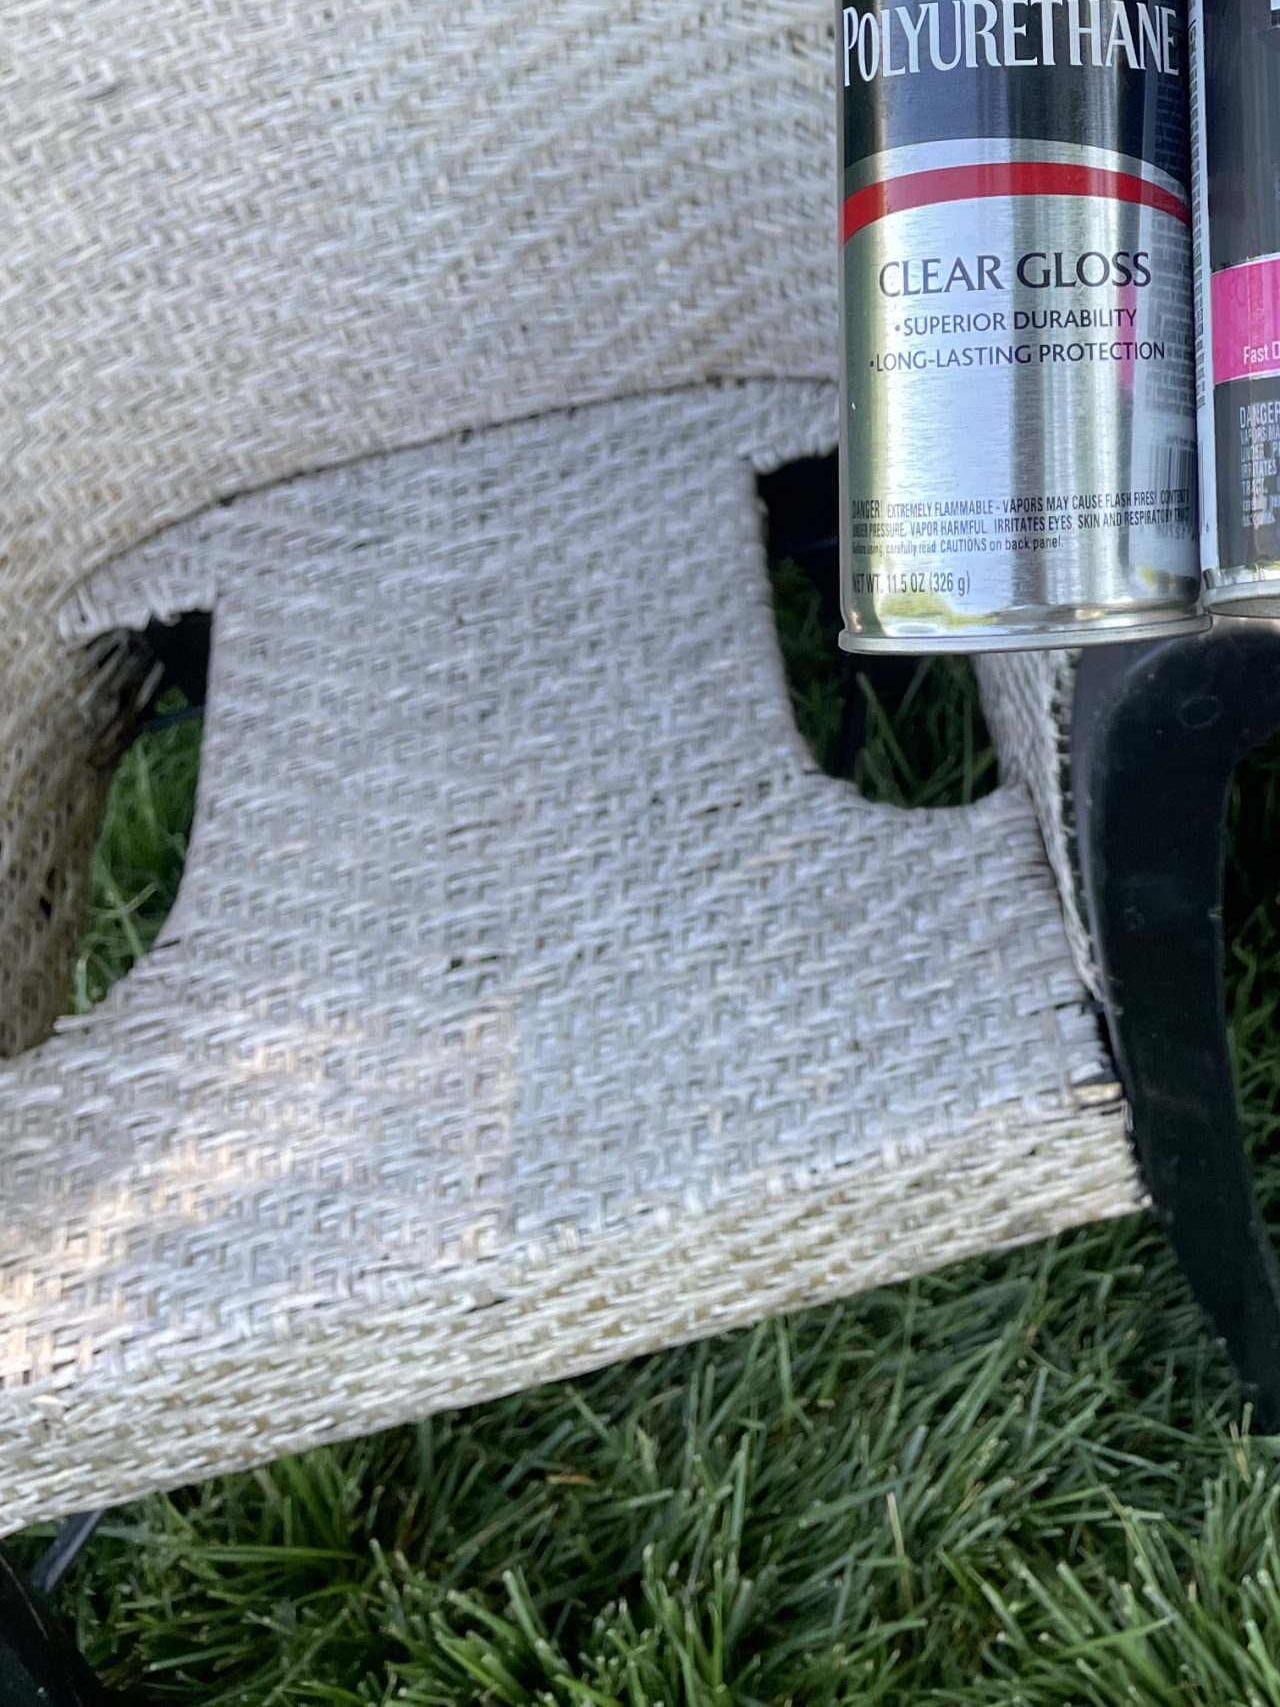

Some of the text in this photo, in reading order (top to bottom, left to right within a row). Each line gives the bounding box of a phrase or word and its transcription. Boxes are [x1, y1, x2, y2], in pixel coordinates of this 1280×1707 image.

[878, 251, 1152, 298] CLEAR GLOSS
[903, 308, 1138, 337] SUPERIOR DURABILITY
[876, 342, 1166, 373] LONG-LASTING PROTECTION
[1243, 344, 1269, 364] Fast
[887, 501, 932, 519] EXTREMELY
[934, 499, 994, 517] FLAMMABLE
[1003, 496, 1043, 514] VAPORS
[1046, 495, 1068, 511] MAY
[1072, 494, 1103, 510] CAUSE
[1105, 492, 1132, 508] FLASH
[1134, 490, 1157, 506] FIRES!
[910, 520, 939, 537] VAPOR
[994, 515, 1045, 534] IRRITATES
[1078, 512, 1101, 529] SKIN
[1103, 511, 1122, 527] AND
[919, 539, 936, 554] read
[940, 537, 987, 553] CAUTIONS
[990, 540, 1002, 552] on
[1005, 537, 1030, 552] back
[1033, 534, 1064, 552] panel.
[910, 572, 926, 593] OZ
[929, 570, 954, 596] (326
[958, 570, 971, 597] g)
